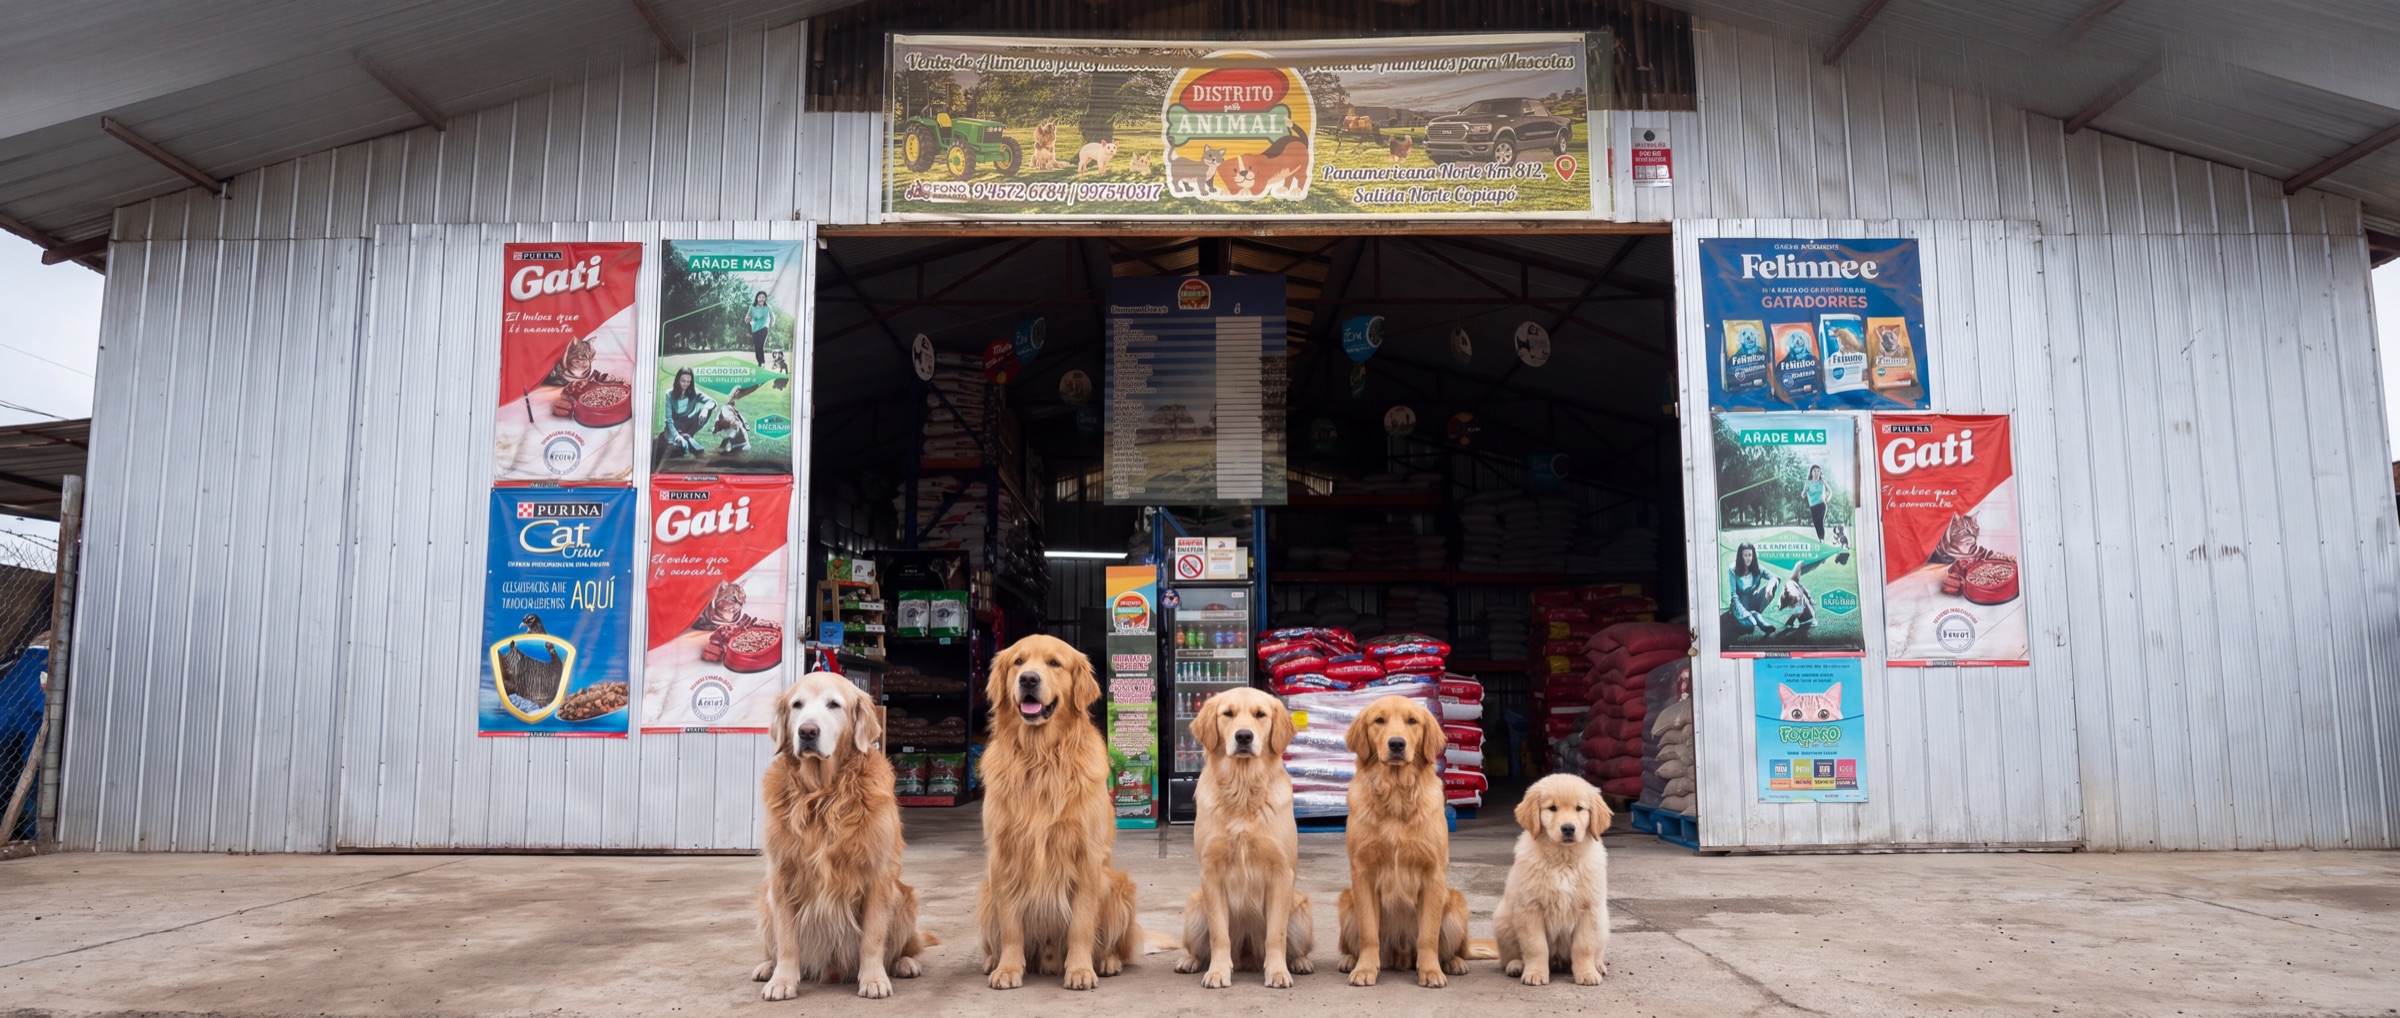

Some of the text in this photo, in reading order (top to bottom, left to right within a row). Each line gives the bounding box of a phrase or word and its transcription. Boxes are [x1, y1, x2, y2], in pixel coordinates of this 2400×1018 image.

[905, 52, 952, 71] Venta
[953, 53, 974, 71] de
[1457, 56, 1498, 75] para
[1500, 52, 1575, 71] Mascotas
[1192, 85, 1274, 102] DISTRITO
[1176, 114, 1283, 134] ANIMAL
[1322, 162, 1547, 180] Panamericana Norte Km 812,
[933, 184, 967, 193] FONO
[974, 184, 985, 199] 9
[987, 183, 1025, 199] 4572
[1028, 183, 1066, 199] 6784
[1079, 183, 1163, 199] 997540317
[1353, 185, 1516, 206] Salida Norte Copiapó
[691, 257, 772, 269] AÑADE MÁS
[1741, 254, 1880, 279] Felinnee
[510, 255, 602, 302] Gati
[1761, 295, 1868, 308] GATADORRES
[1794, 430, 1825, 443] MÁS
[1882, 429, 1974, 475] Gati
[670, 491, 709, 500] PURINA
[537, 504, 600, 516] PURINA
[655, 496, 750, 544] Gati
[519, 519, 591, 554] Cat
[570, 575, 616, 612] AQUÍ
